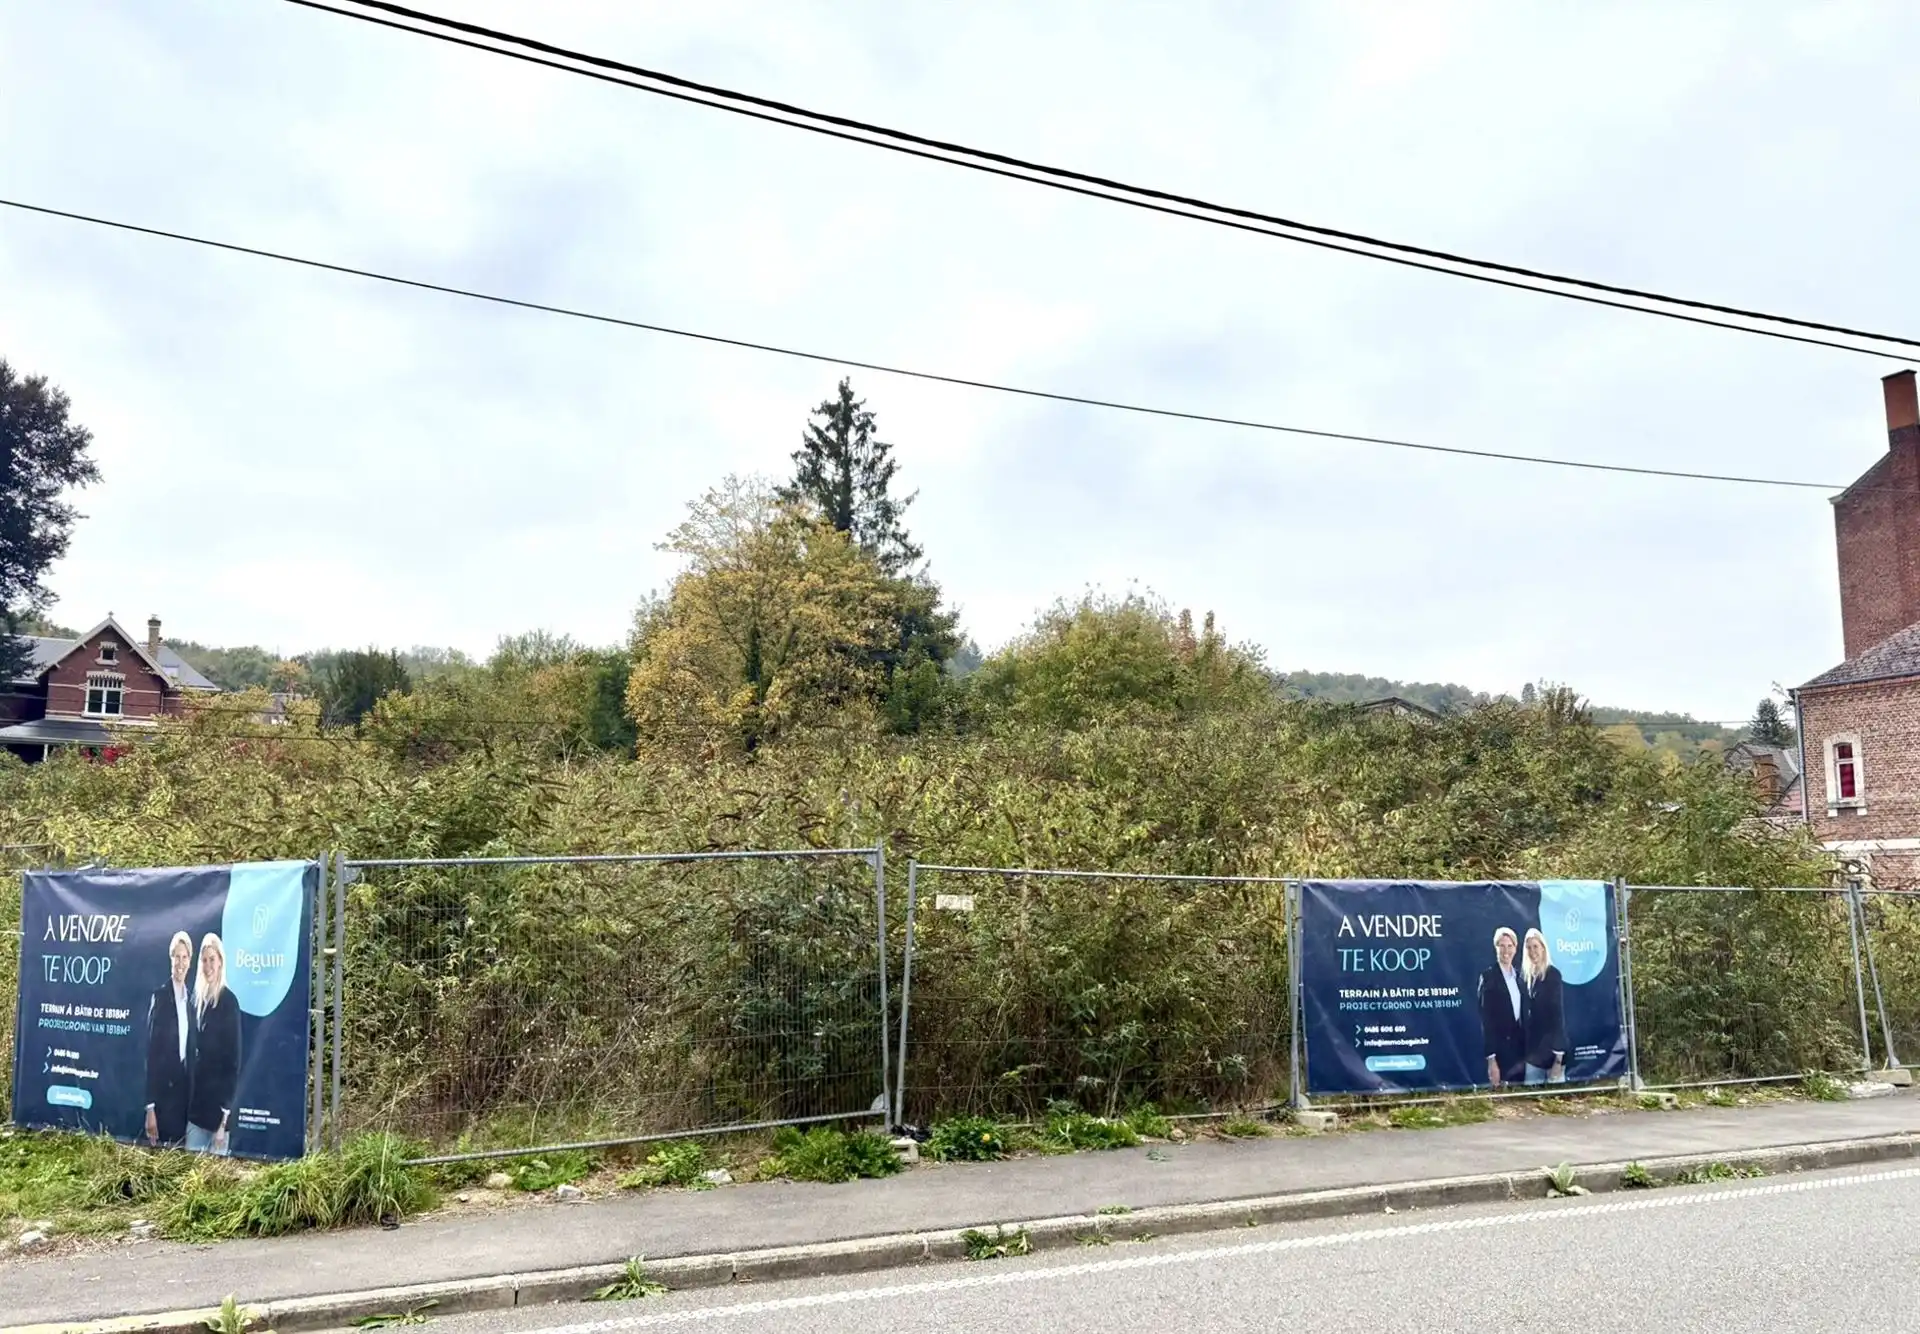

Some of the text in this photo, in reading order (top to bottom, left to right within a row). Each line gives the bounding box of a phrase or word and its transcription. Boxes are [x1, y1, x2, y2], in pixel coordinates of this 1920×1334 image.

[60, 914, 130, 942] VENDRE
[1338, 914, 1443, 937] A VENDRE
[1556, 937, 1594, 956] Beguin
[42, 954, 111, 985] TE KOOP
[236, 948, 284, 974] Beguin
[1337, 948, 1431, 971] TE KOOP
[1339, 988, 1379, 999] TERRAIN
[1418, 988, 1429, 997] DE
[93, 1008, 104, 1018] DE
[1339, 1001, 1412, 1011] PROJECTGROND
[1415, 1001, 1433, 1009] VAN
[91, 1023, 106, 1034] VAN
